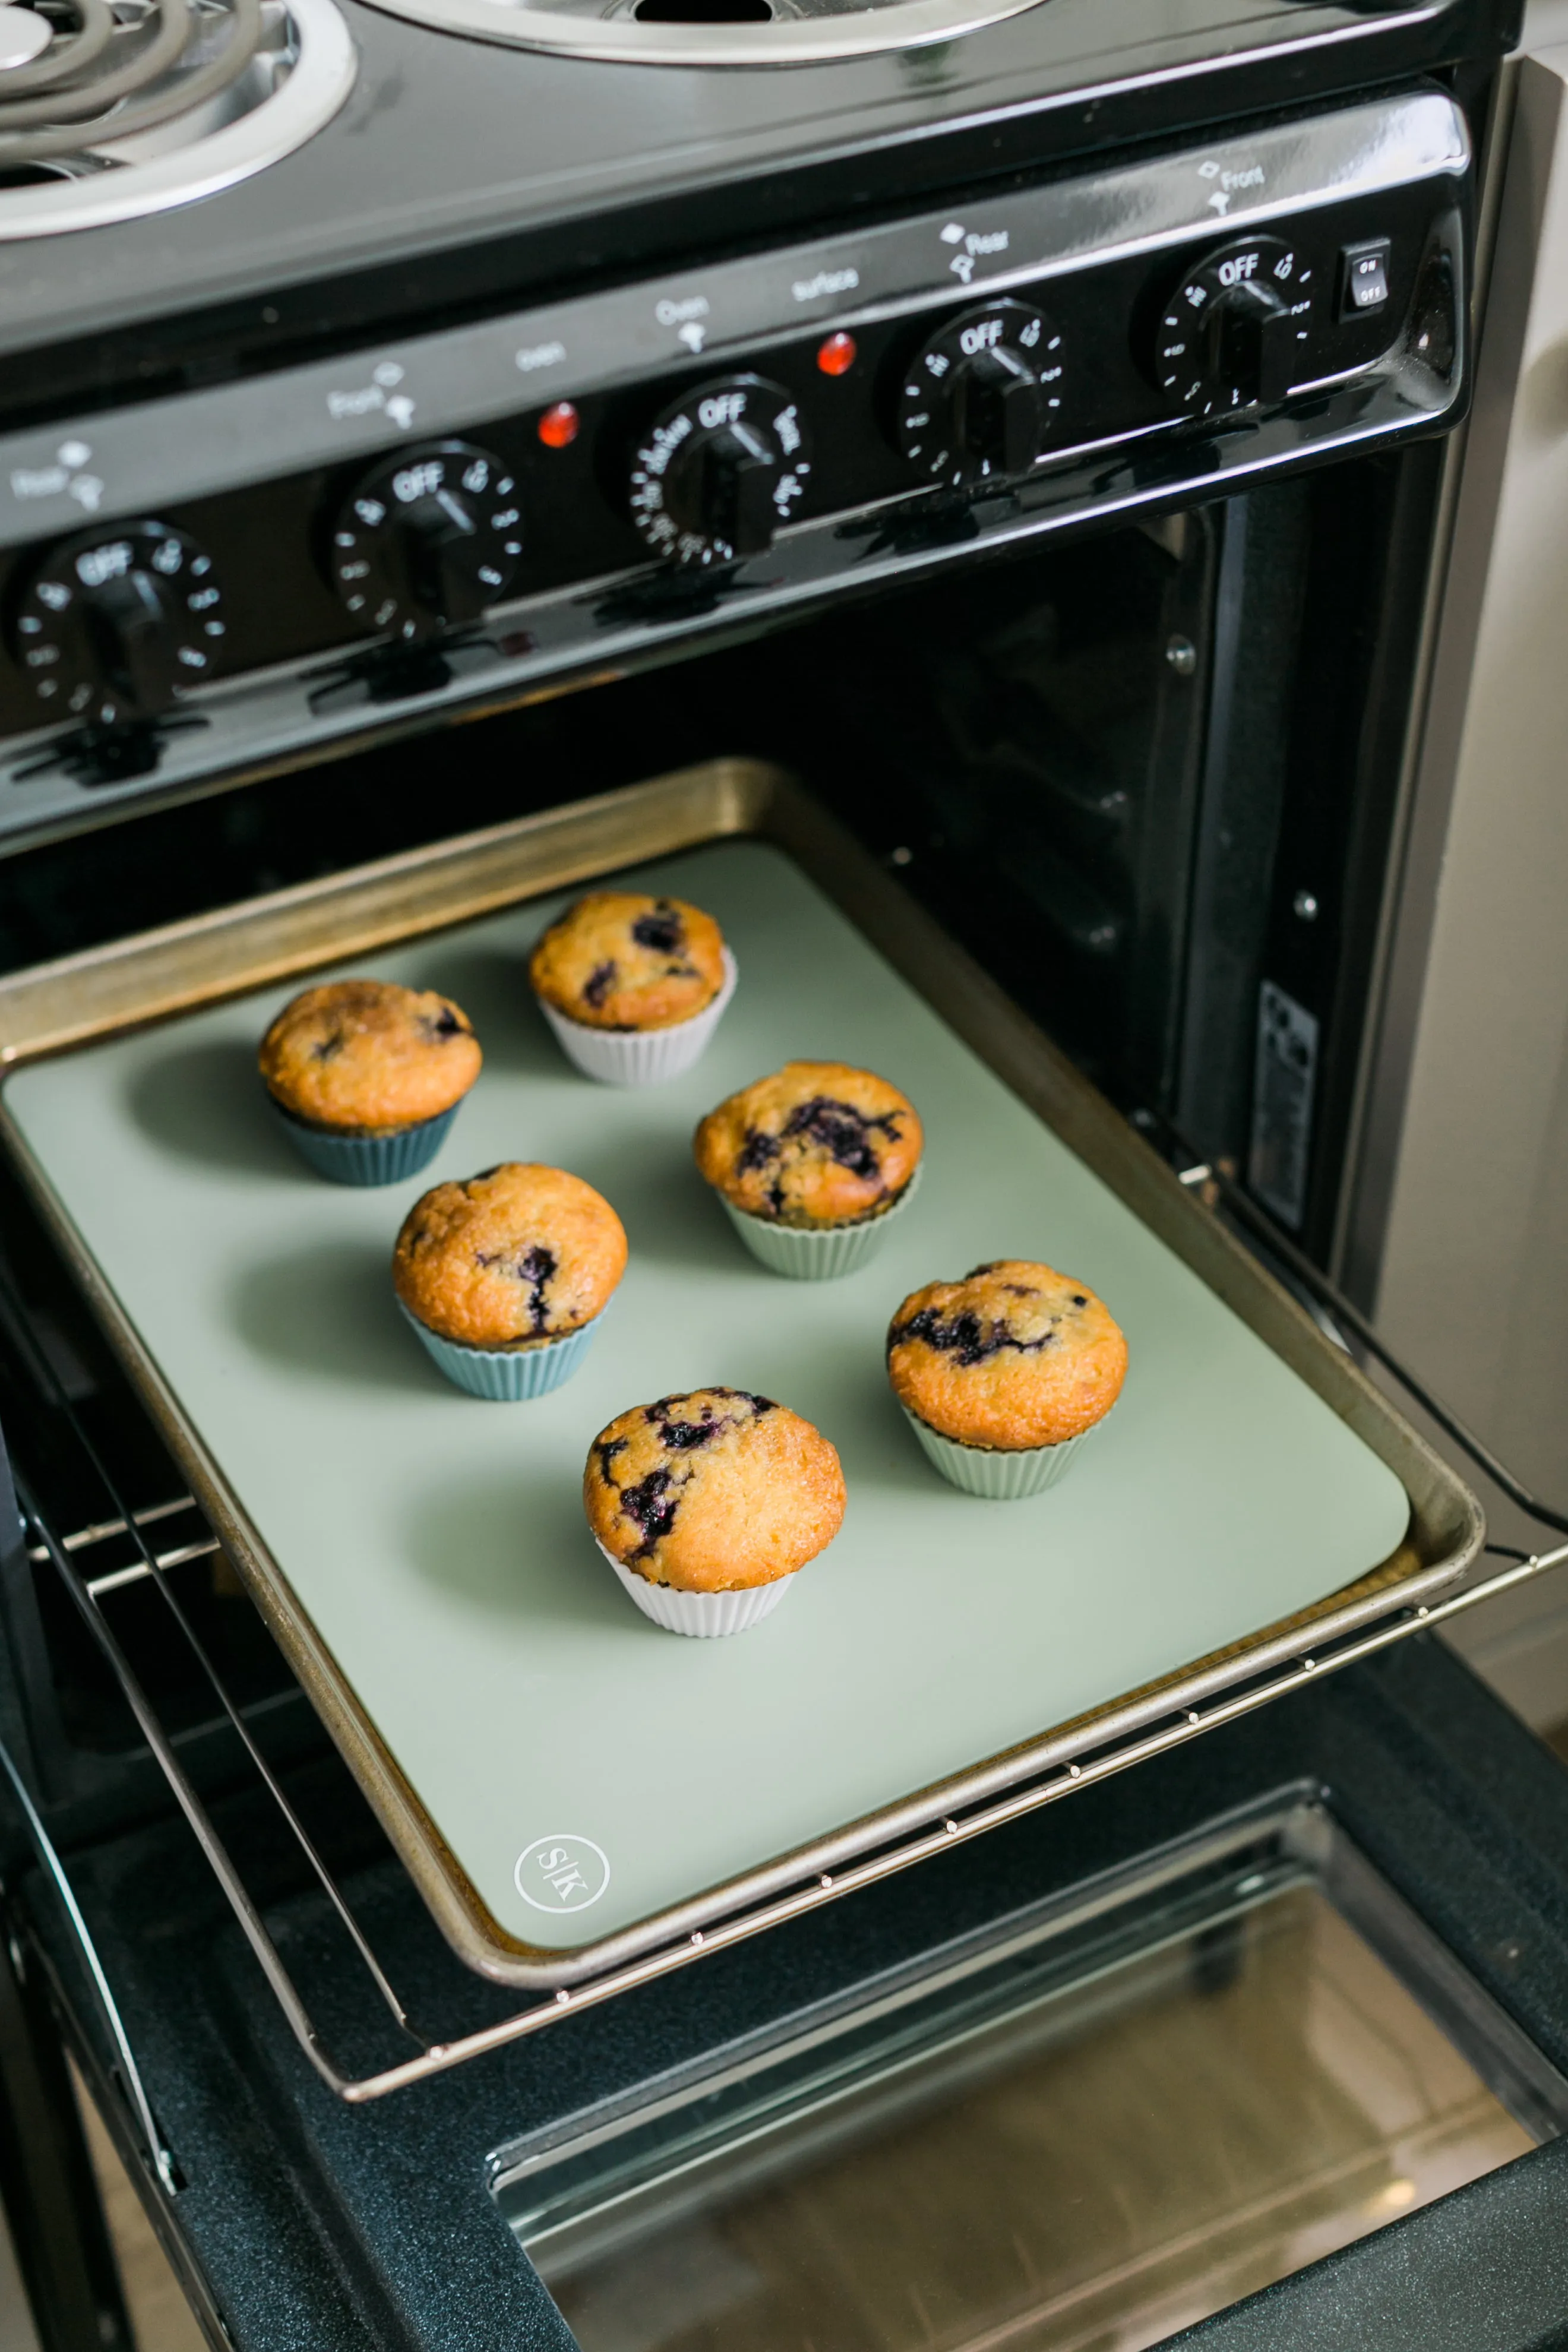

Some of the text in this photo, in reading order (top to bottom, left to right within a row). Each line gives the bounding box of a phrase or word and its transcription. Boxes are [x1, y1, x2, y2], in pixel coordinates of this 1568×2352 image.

[1221, 165, 1264, 191] Front
[965, 231, 1009, 257] Rear
[1219, 253, 1259, 286] OFF
[1273, 257, 1292, 280] LO
[1359, 260, 1376, 274] ON
[792, 268, 859, 302] surface
[1361, 286, 1380, 302] OFF
[655, 296, 710, 325] Oven
[960, 320, 1003, 355] OFF
[698, 393, 747, 428] OFF
[393, 461, 444, 502] OFF
[75, 540, 134, 587] OFF
